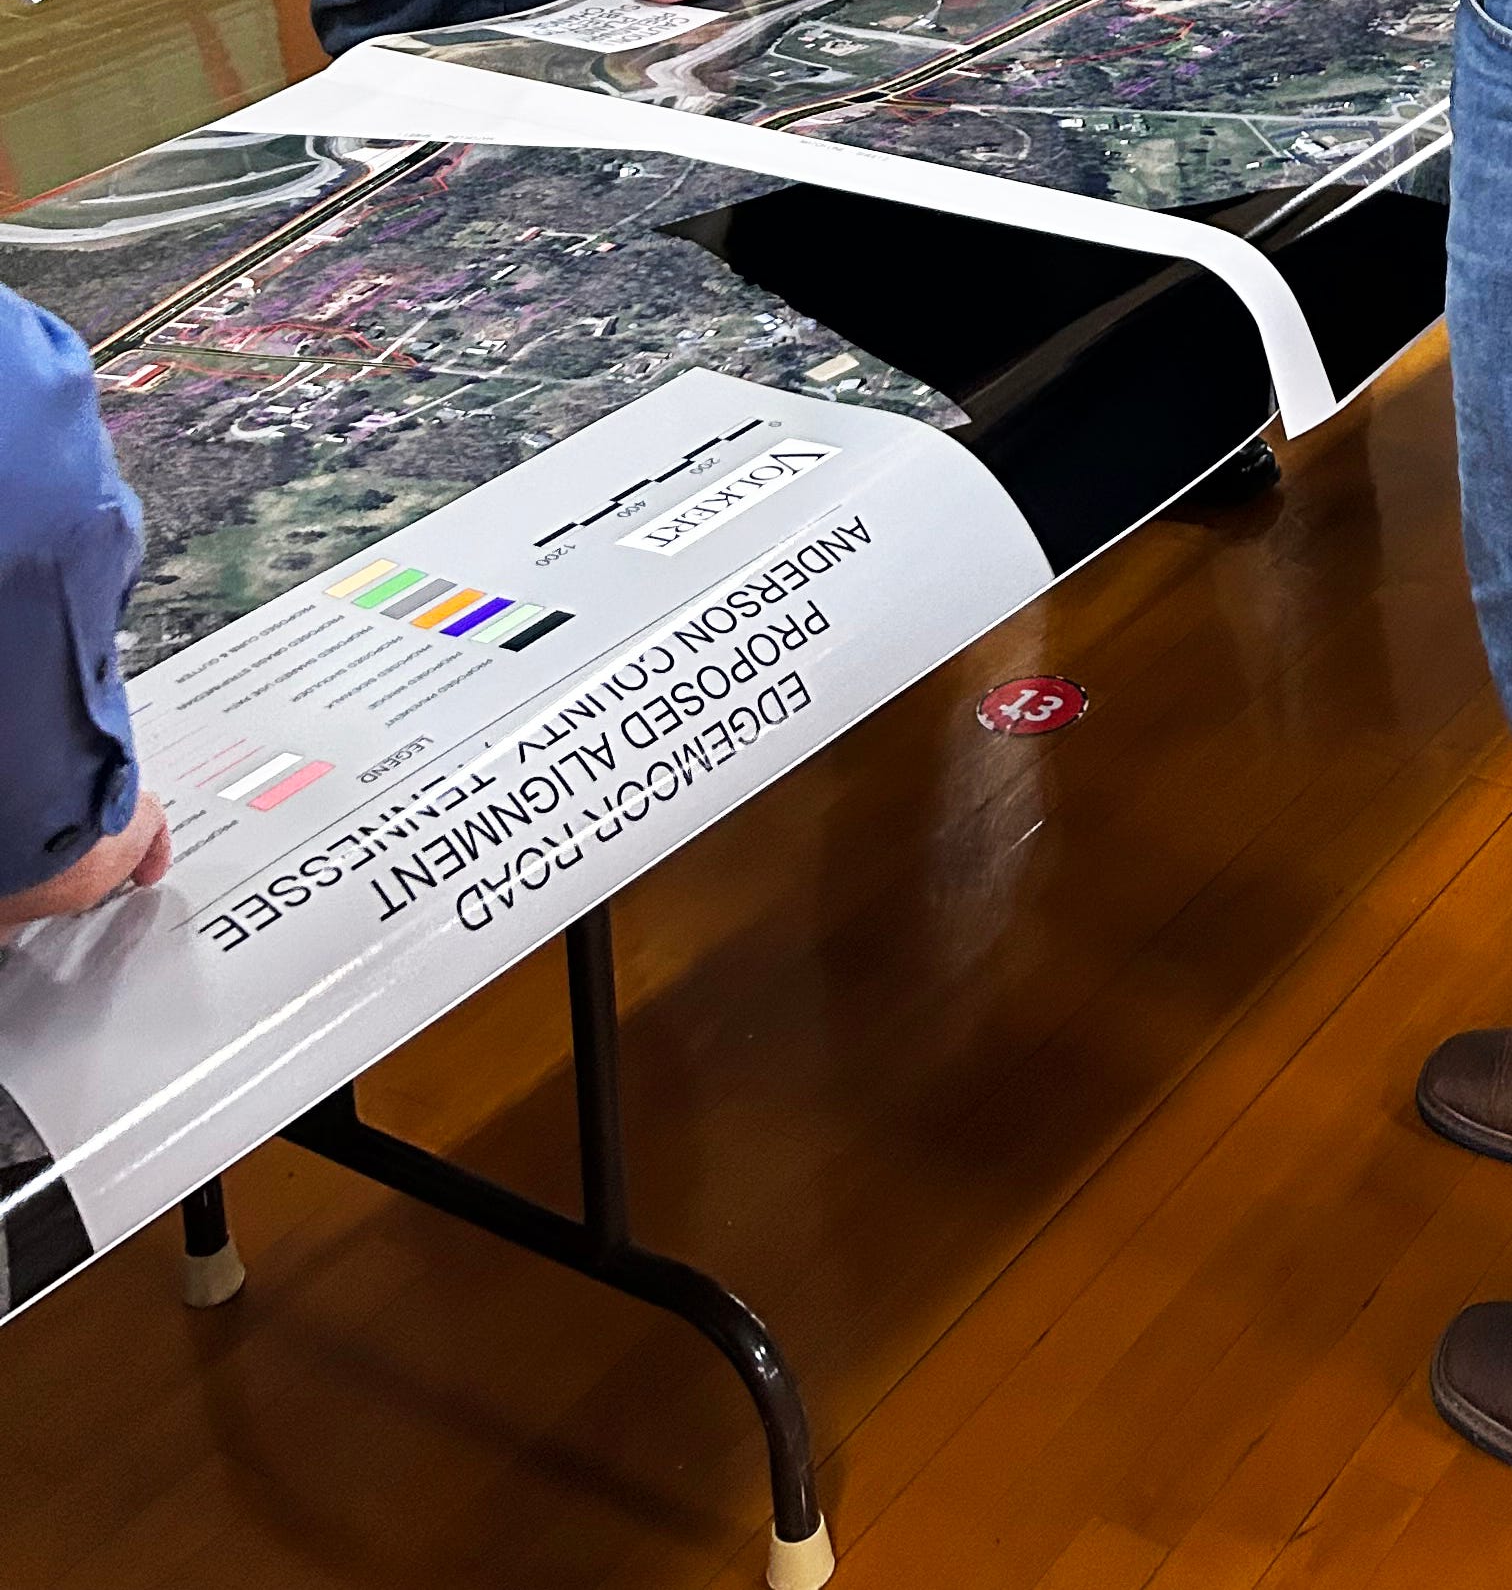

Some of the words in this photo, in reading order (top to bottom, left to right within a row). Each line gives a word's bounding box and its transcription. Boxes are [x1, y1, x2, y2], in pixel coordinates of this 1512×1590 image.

[689, 456, 721, 475] 200
[616, 499, 647, 519] 400
[643, 451, 830, 548] VOLKERT
[535, 543, 577, 567] 1200
[673, 515, 872, 654] ANDERSON
[259, 604, 317, 637] PROPOSED
[288, 614, 345, 648] PROPOSED
[317, 625, 375, 658] PROPOSED
[347, 635, 404, 668] PROPOSED
[377, 643, 433, 678] PROPOSED
[407, 650, 463, 686] PROPOSED
[438, 658, 493, 694] PROPOSED
[620, 599, 831, 749] PROPOSED
[999, 689, 1064, 722] 13
[356, 735, 434, 784] LEGEND
[583, 669, 812, 843] EDGEMOOR
[371, 731, 616, 922] ALIGNMENT
[455, 822, 584, 931] ROAD
